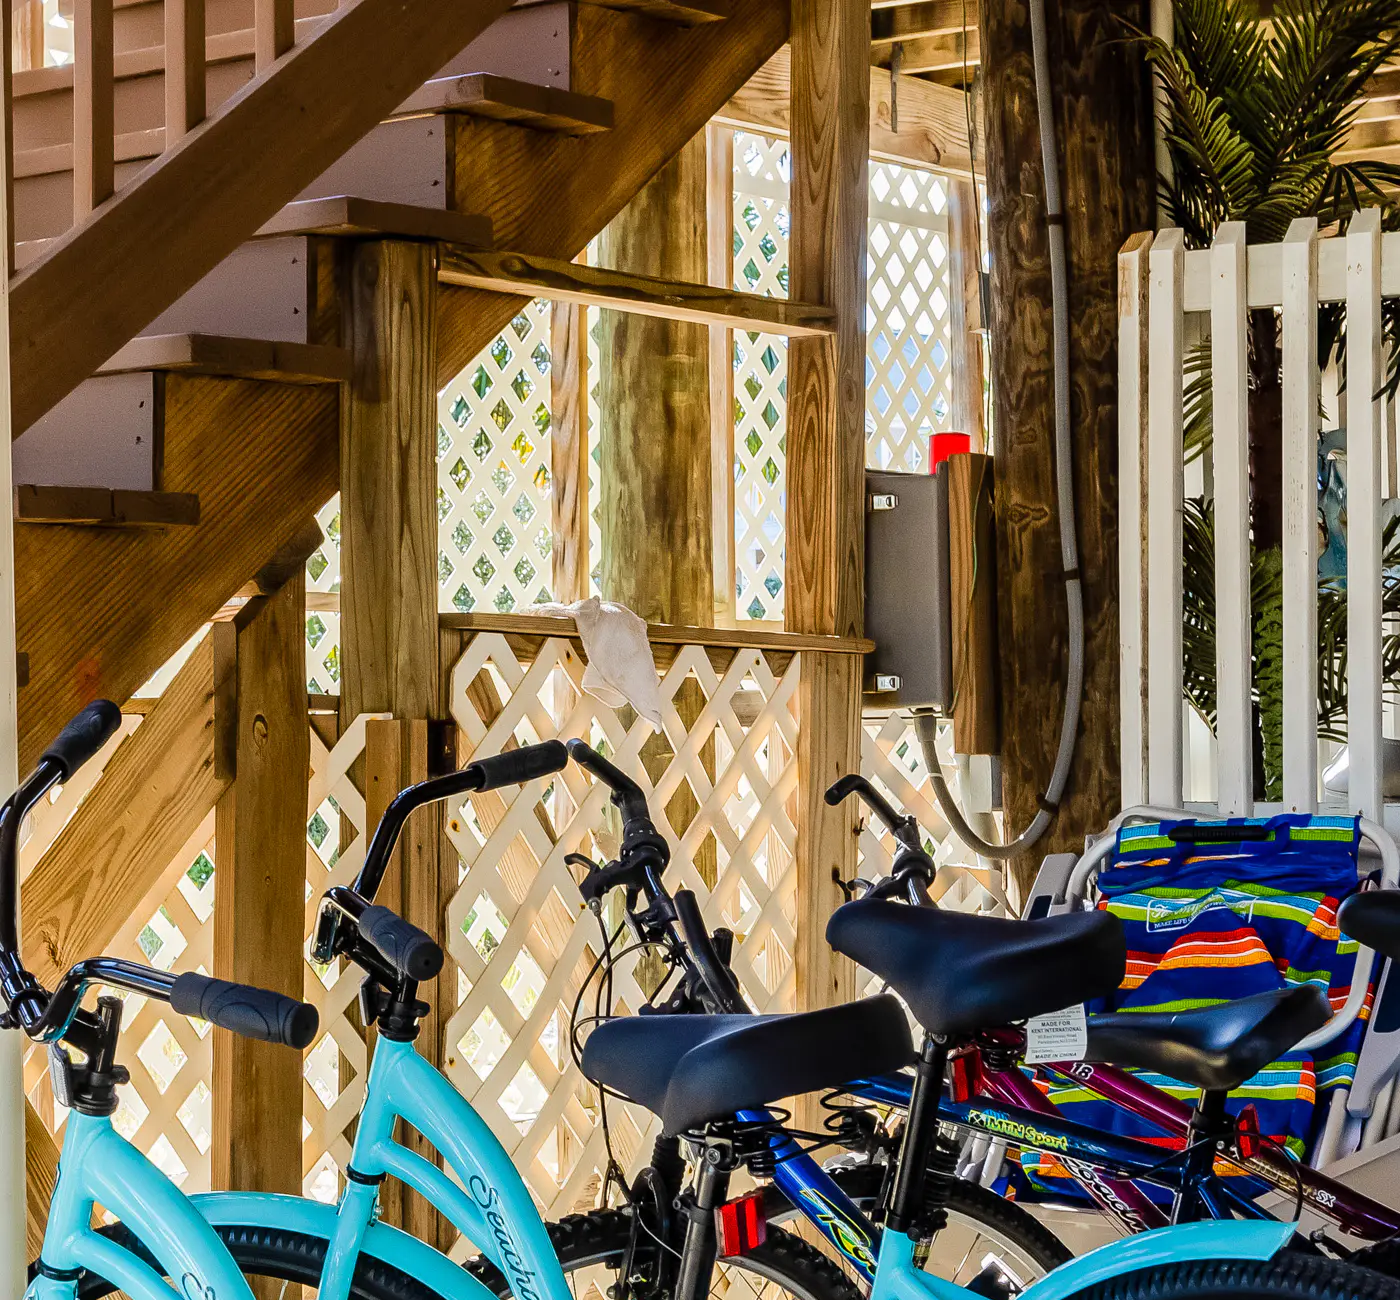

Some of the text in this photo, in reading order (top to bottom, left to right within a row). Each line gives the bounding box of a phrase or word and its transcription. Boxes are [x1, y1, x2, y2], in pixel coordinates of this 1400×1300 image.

[1154, 920, 1173, 929] MAKE
[1070, 1062, 1094, 1080] 18
[985, 1117, 1068, 1151] MTN Sport
[1316, 1190, 1337, 1208] SX
